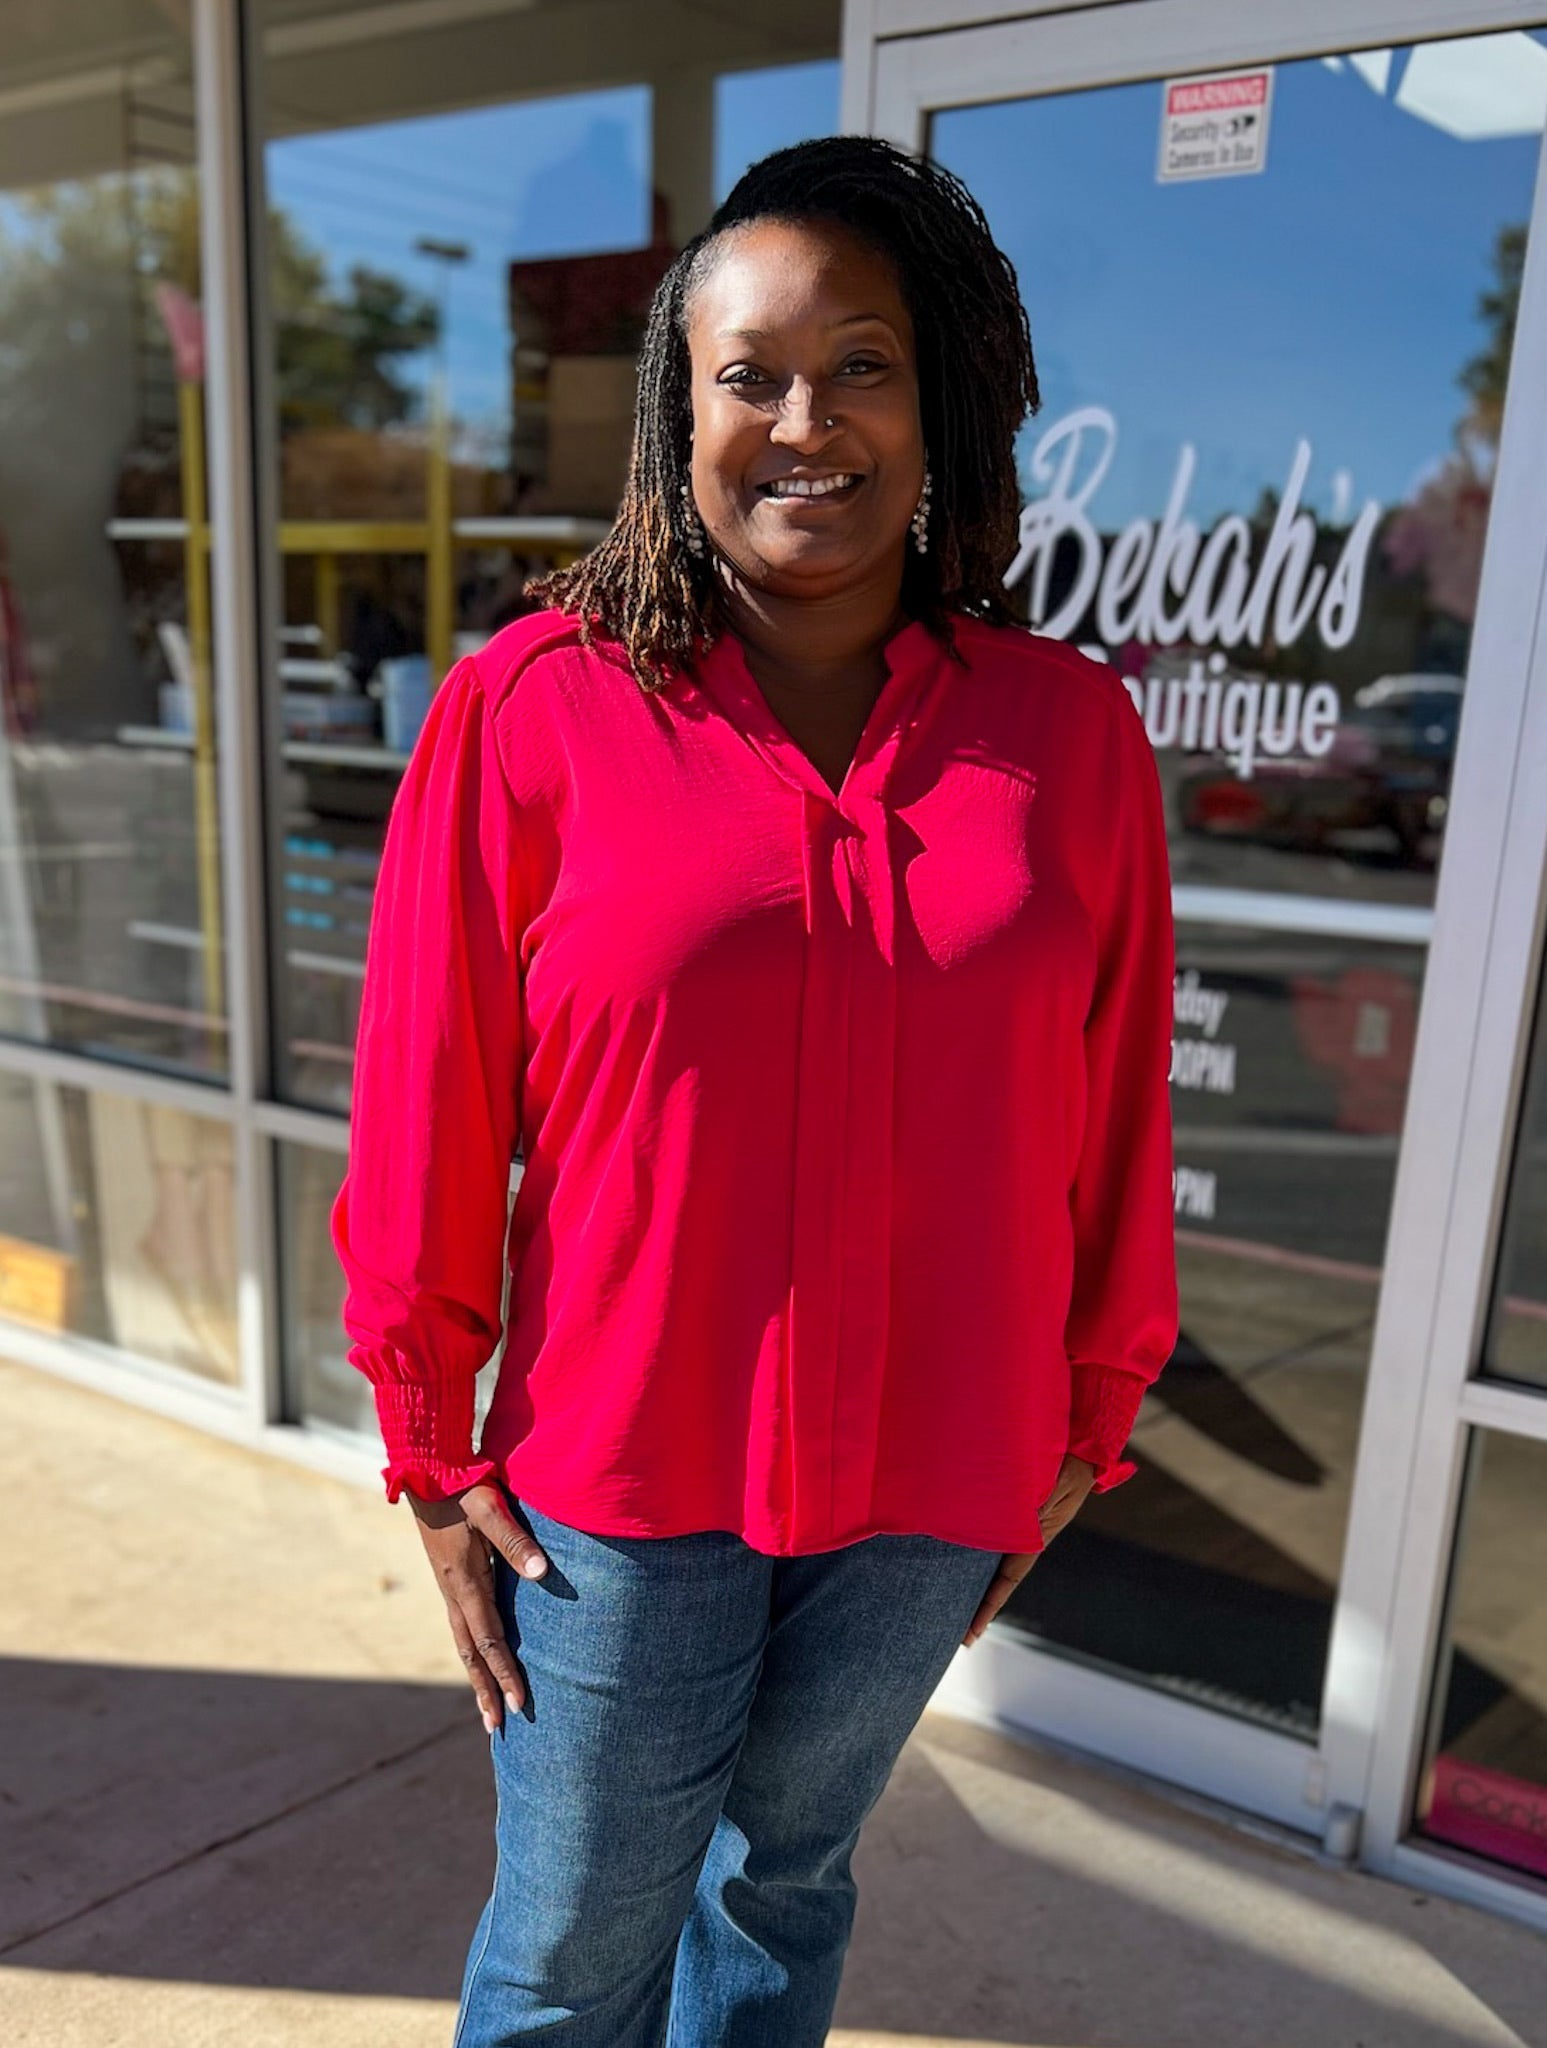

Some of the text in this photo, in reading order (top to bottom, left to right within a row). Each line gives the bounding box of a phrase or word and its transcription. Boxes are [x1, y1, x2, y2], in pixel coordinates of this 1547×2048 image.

[1171, 78, 1264, 111] WARNING
[1002, 405, 1381, 649] Bekah's
[1077, 643, 1341, 780] utique
